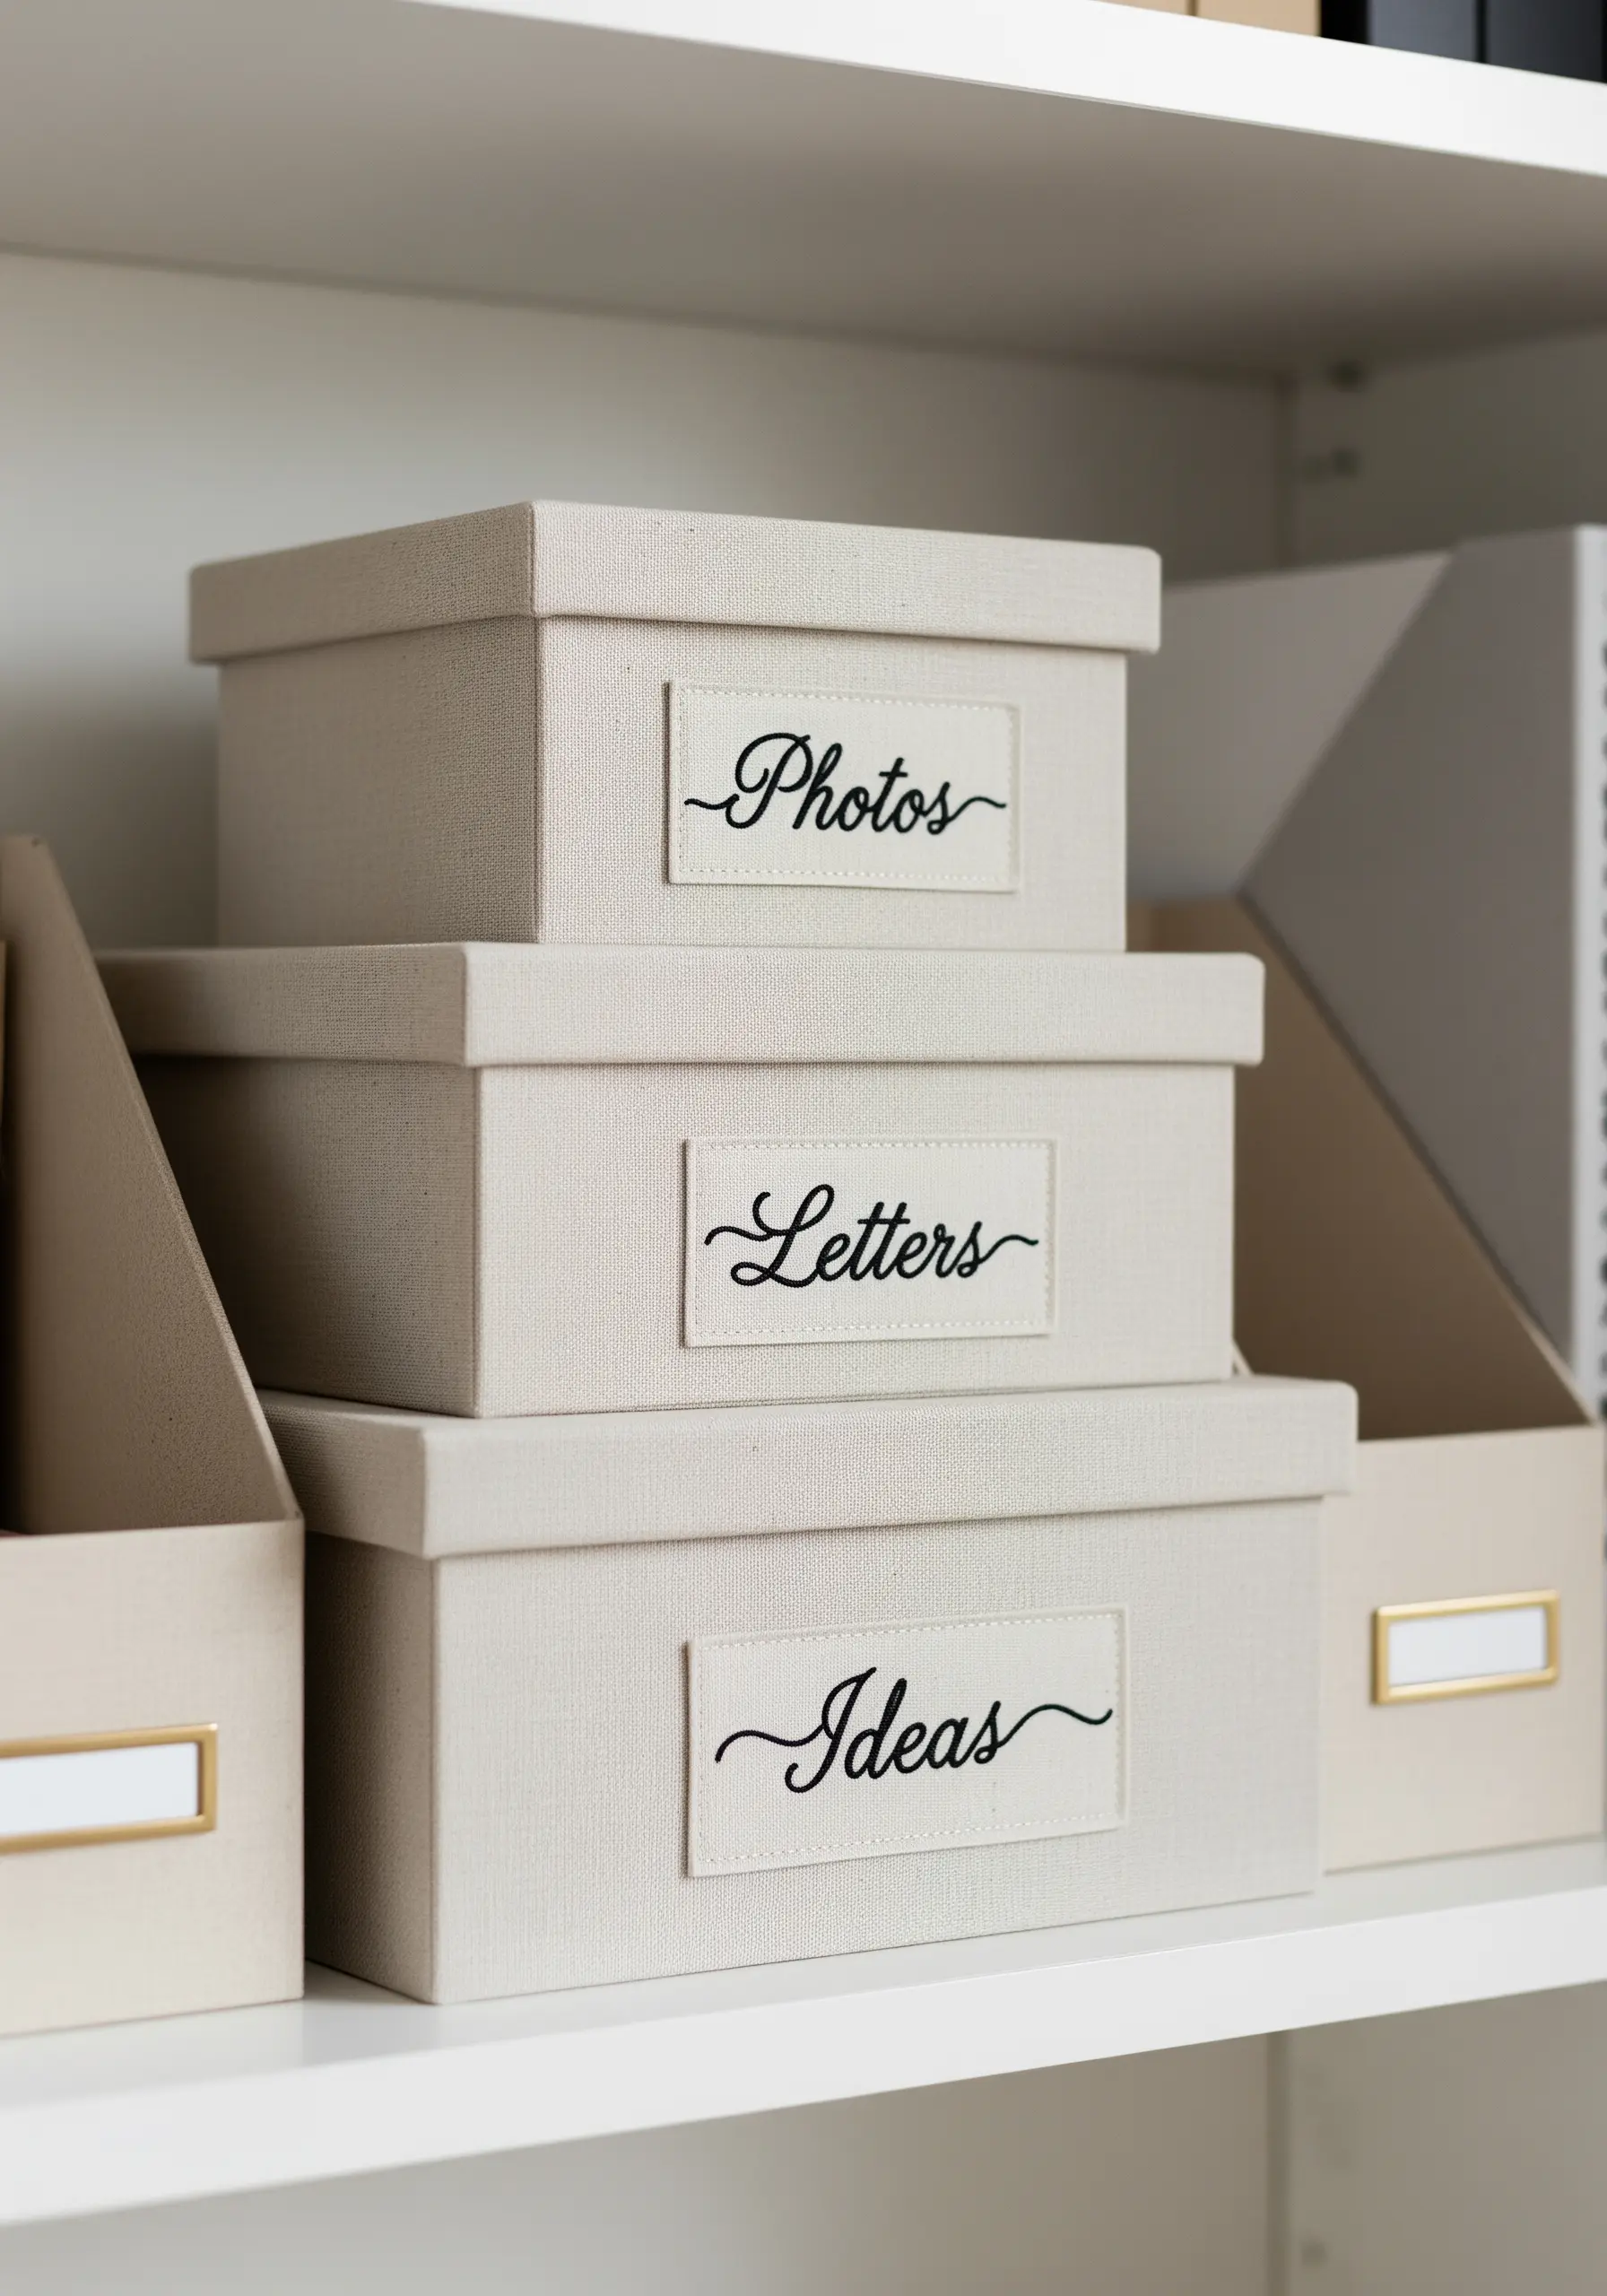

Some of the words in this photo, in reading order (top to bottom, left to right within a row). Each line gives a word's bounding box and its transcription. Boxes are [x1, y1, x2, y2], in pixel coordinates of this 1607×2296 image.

[683, 732, 1006, 835] Photos
[703, 1183, 1039, 1289] Letters
[714, 1666, 1113, 1794] Ideas
